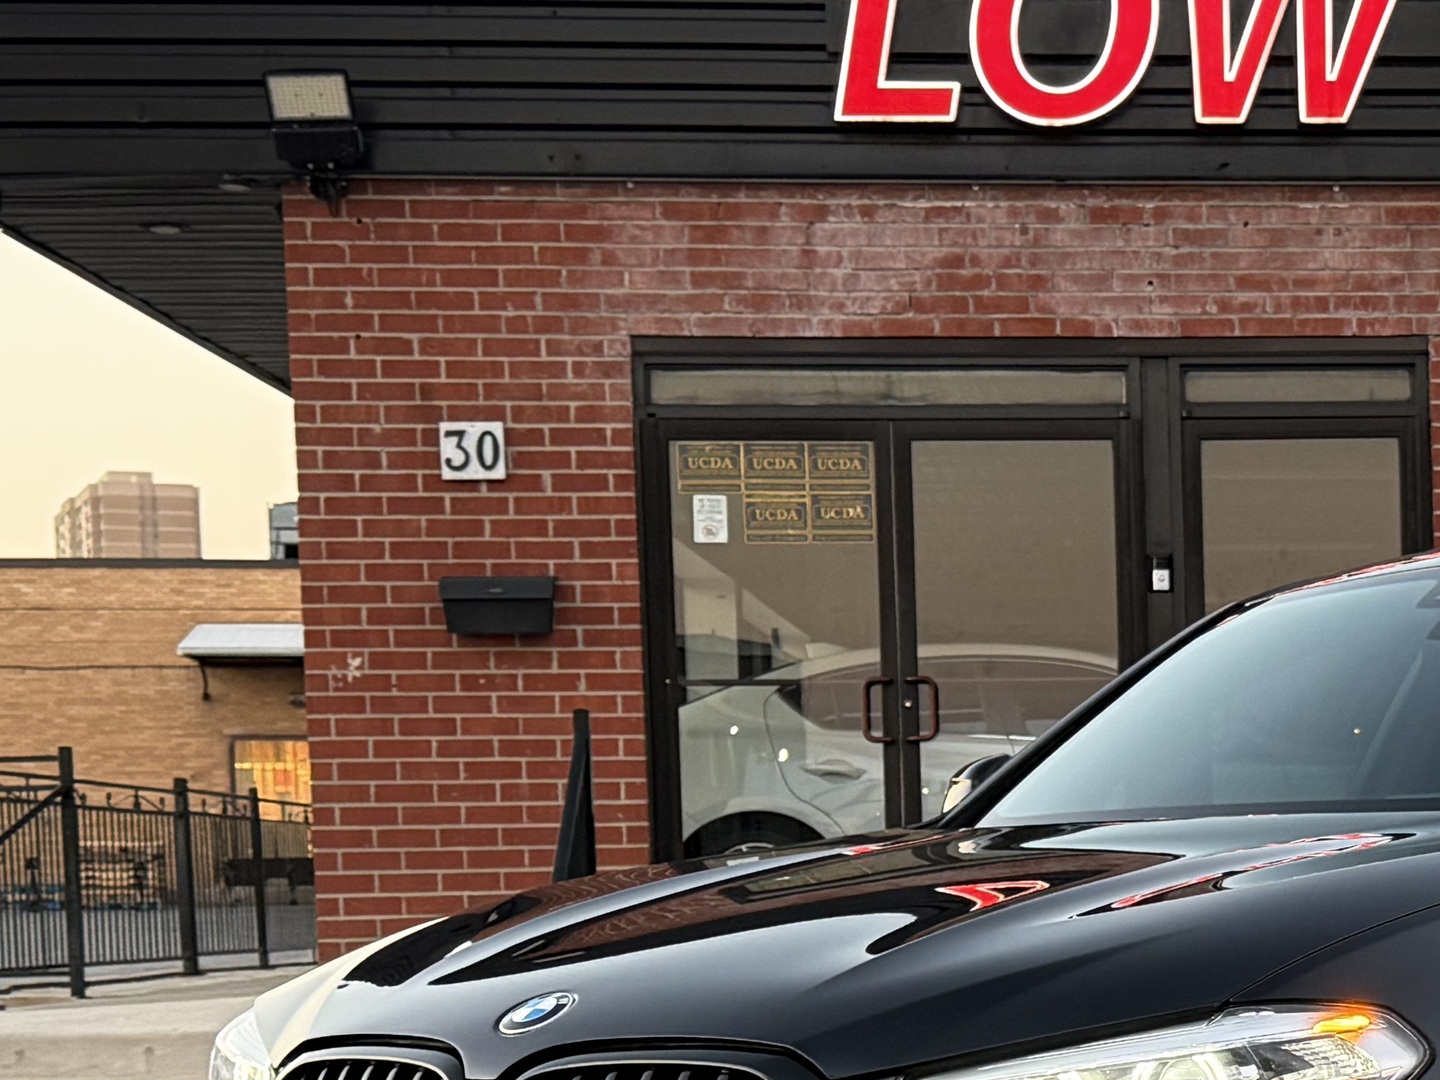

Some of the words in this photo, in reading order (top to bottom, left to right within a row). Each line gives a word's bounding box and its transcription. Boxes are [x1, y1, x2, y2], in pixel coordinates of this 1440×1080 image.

[833, 0, 1398, 126] LOW
[443, 429, 500, 472] 30
[687, 457, 734, 469] UCDA
[752, 458, 798, 470] UCDA
[817, 458, 862, 470] UCDA
[755, 508, 799, 521] UCDA
[820, 506, 865, 519] UCDA
